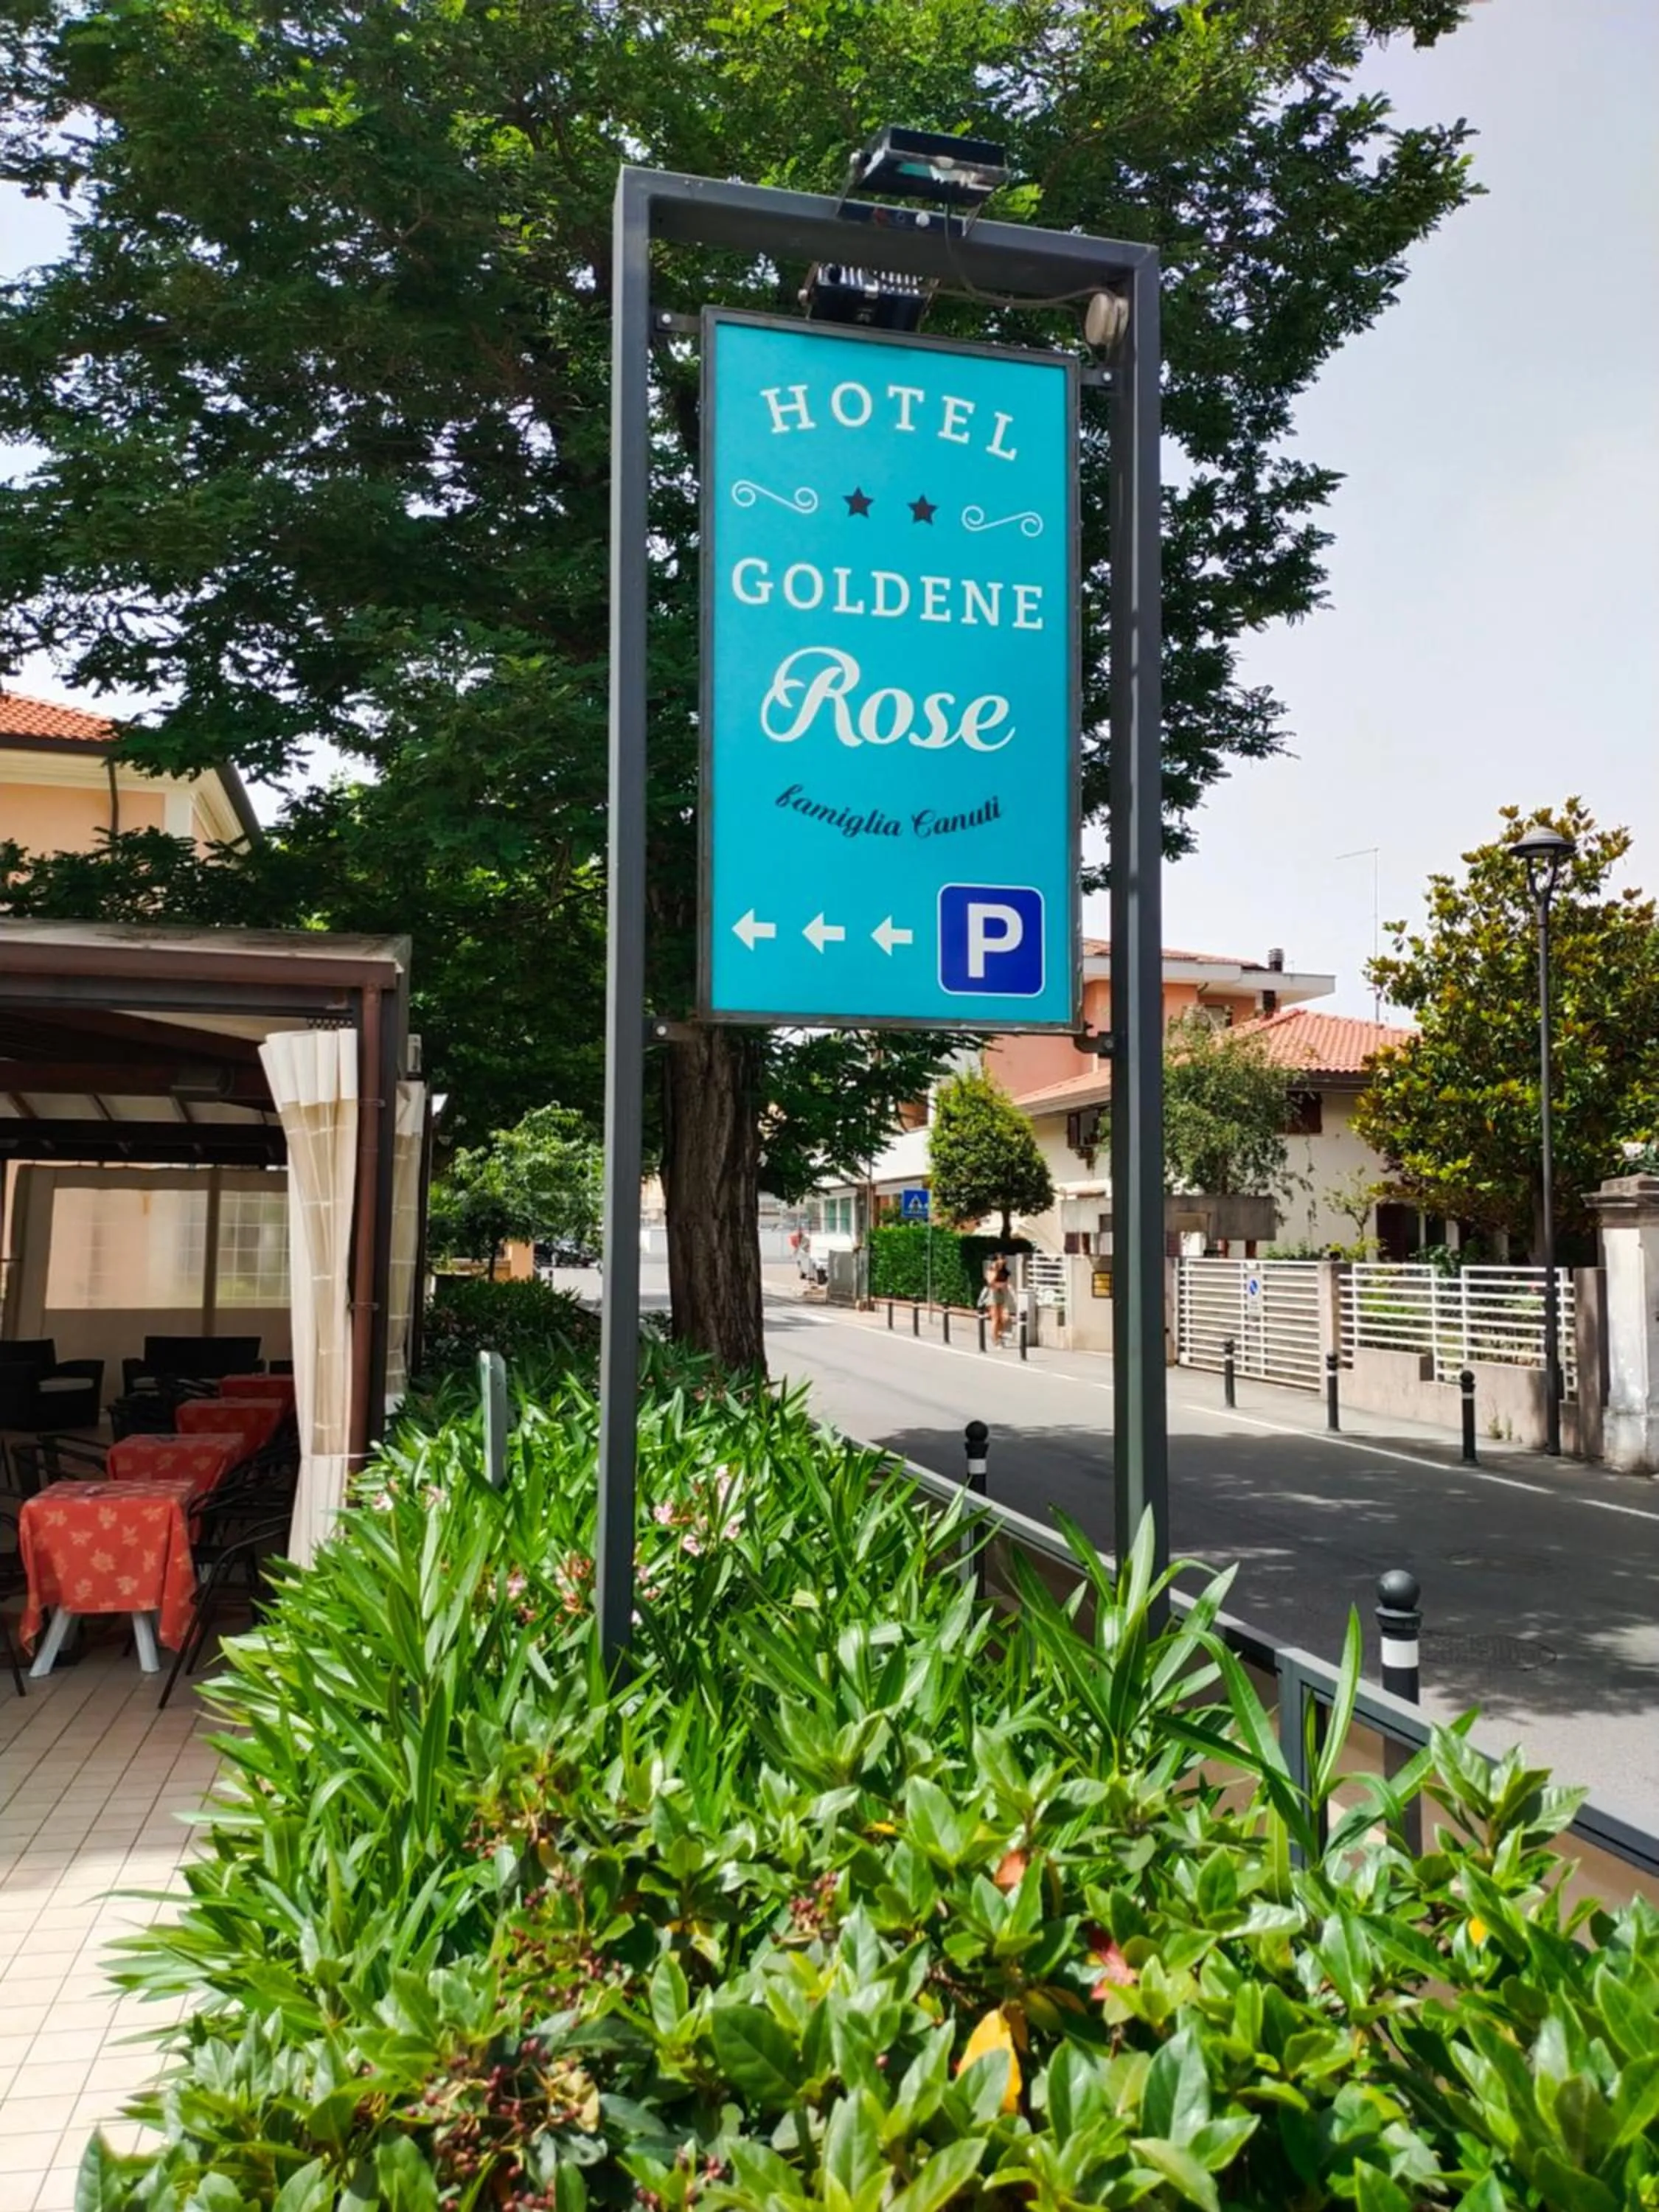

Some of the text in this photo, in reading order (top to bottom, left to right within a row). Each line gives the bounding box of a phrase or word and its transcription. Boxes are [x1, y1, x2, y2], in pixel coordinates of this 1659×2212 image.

[760, 381, 1018, 462] HOTEL
[731, 557, 1044, 630] GOLDENE
[760, 646, 1016, 752] Rose
[775, 784, 1003, 839] famiglia Canuti
[967, 902, 1024, 979] P
